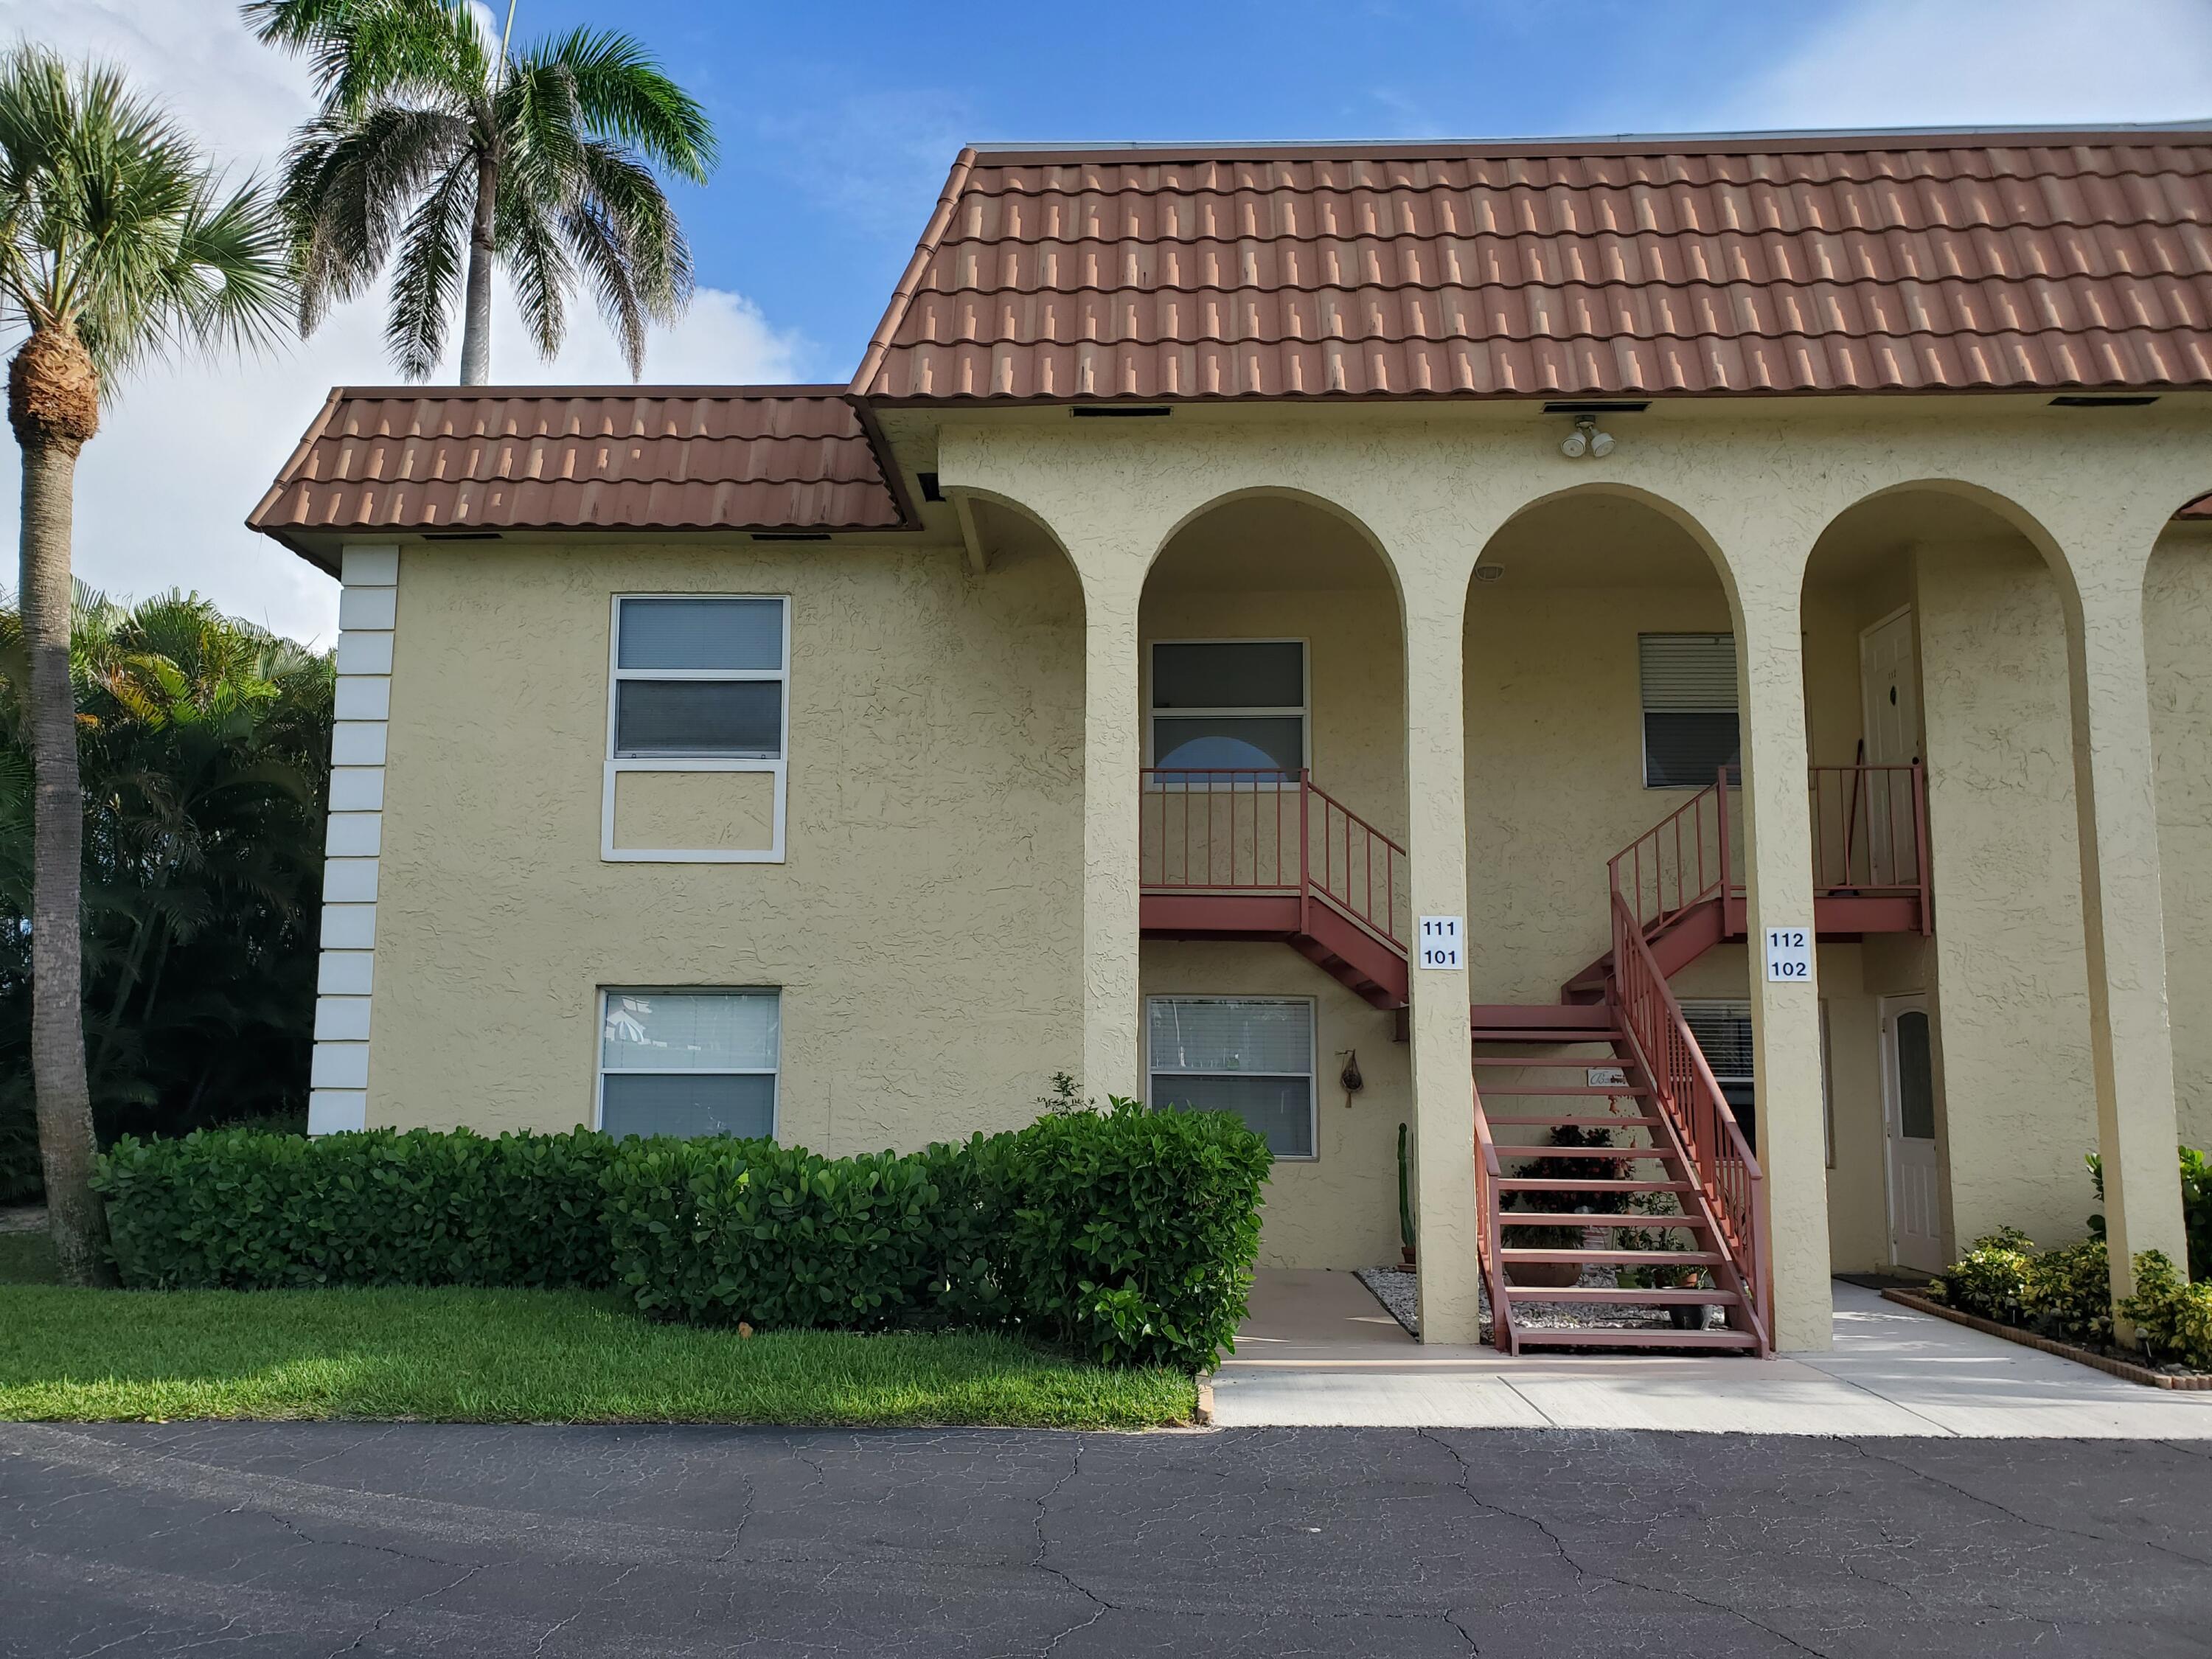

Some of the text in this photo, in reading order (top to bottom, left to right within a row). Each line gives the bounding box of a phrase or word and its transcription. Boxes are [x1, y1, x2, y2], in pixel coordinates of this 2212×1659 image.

[1423, 922, 1453, 936] 111
[1770, 933, 1804, 947] 112
[1425, 950, 1455, 964] 101
[1772, 962, 1806, 976] 102
